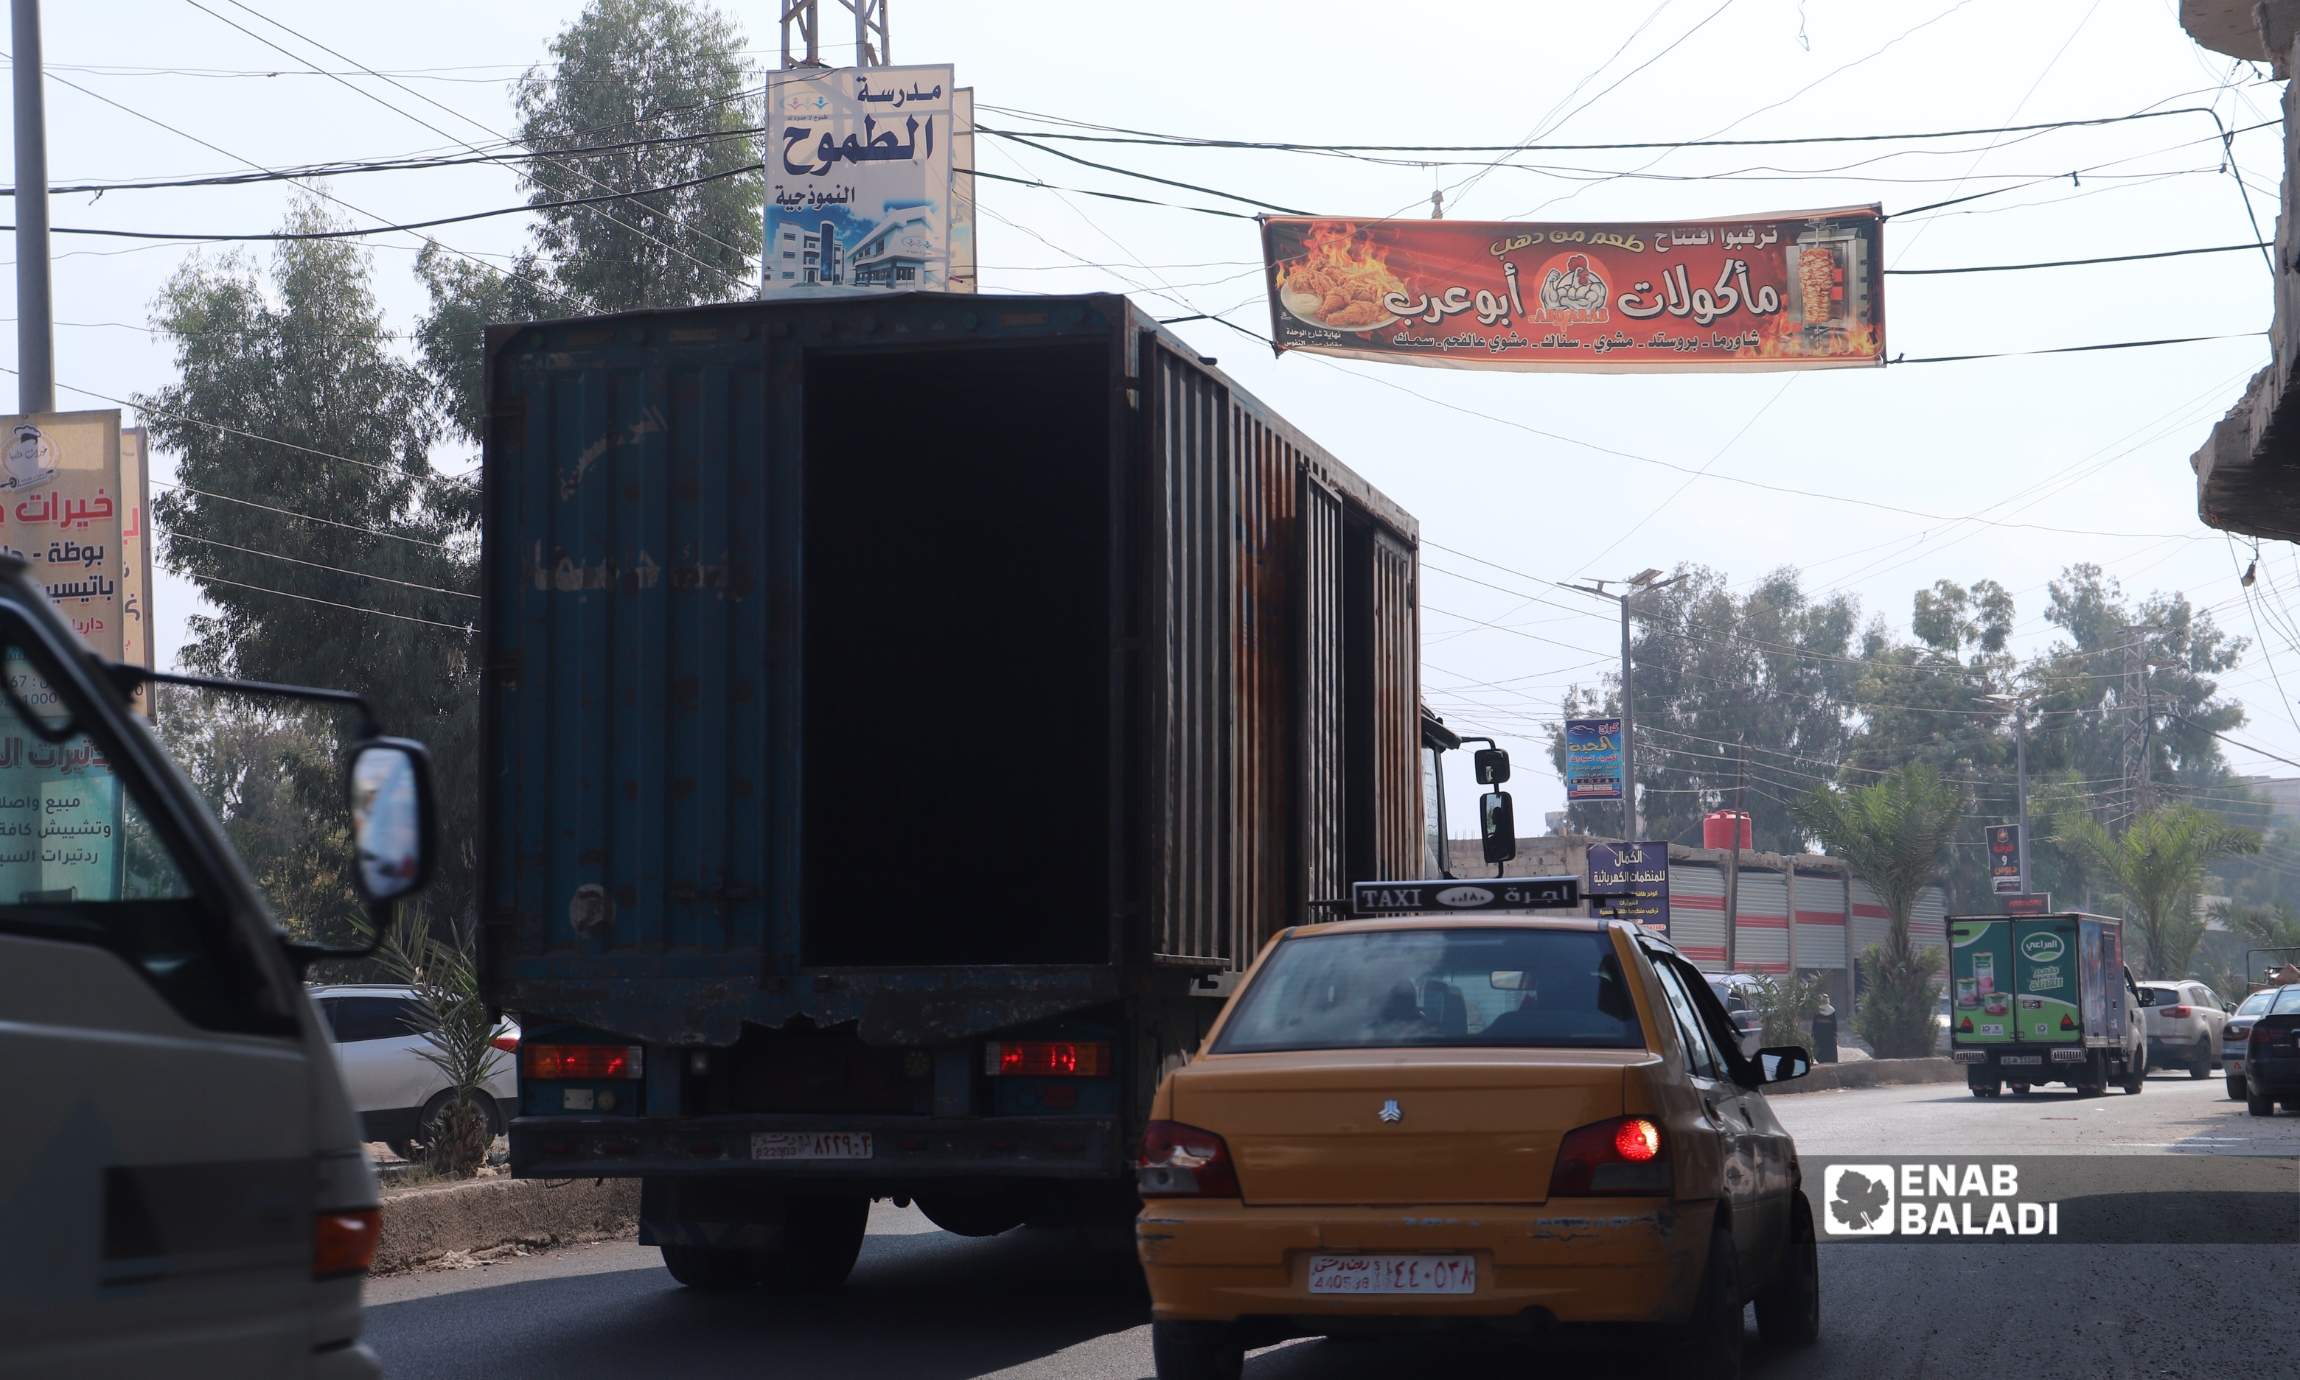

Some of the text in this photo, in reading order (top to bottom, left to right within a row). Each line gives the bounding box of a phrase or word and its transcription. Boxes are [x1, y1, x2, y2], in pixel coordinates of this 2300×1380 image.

[856, 76, 942, 108] مدرسة
[783, 113, 934, 176] الطموح
[775, 183, 855, 213] النموذجية
[1490, 230, 1645, 261] طعم من دهب
[1654, 226, 1778, 252] ترقبوا افتتاح
[1383, 258, 1781, 327] مأكولات أبو عرب
[1308, 330, 1322, 338] شارع
[1393, 332, 1434, 348] سمك
[1443, 332, 1486, 351] عالفحم
[1488, 331, 1528, 353] مشوي
[1541, 333, 1580, 348] سناك
[1595, 331, 1633, 353] مشوي
[1649, 332, 1699, 352] بروستد
[1712, 330, 1760, 351] شاورما
[15, 489, 113, 528] خيرات
[48, 541, 104, 568] بوظة
[1599, 722, 1619, 735] كراج
[46, 798, 80, 814] مبيع
[41, 848, 98, 865] ردتيرات
[1614, 850, 1643, 867] الكمال
[1593, 870, 1666, 886] للمنظمات الكهربائية
[1362, 889, 1422, 907] TAXI
[2026, 940, 2058, 951] المراعي
